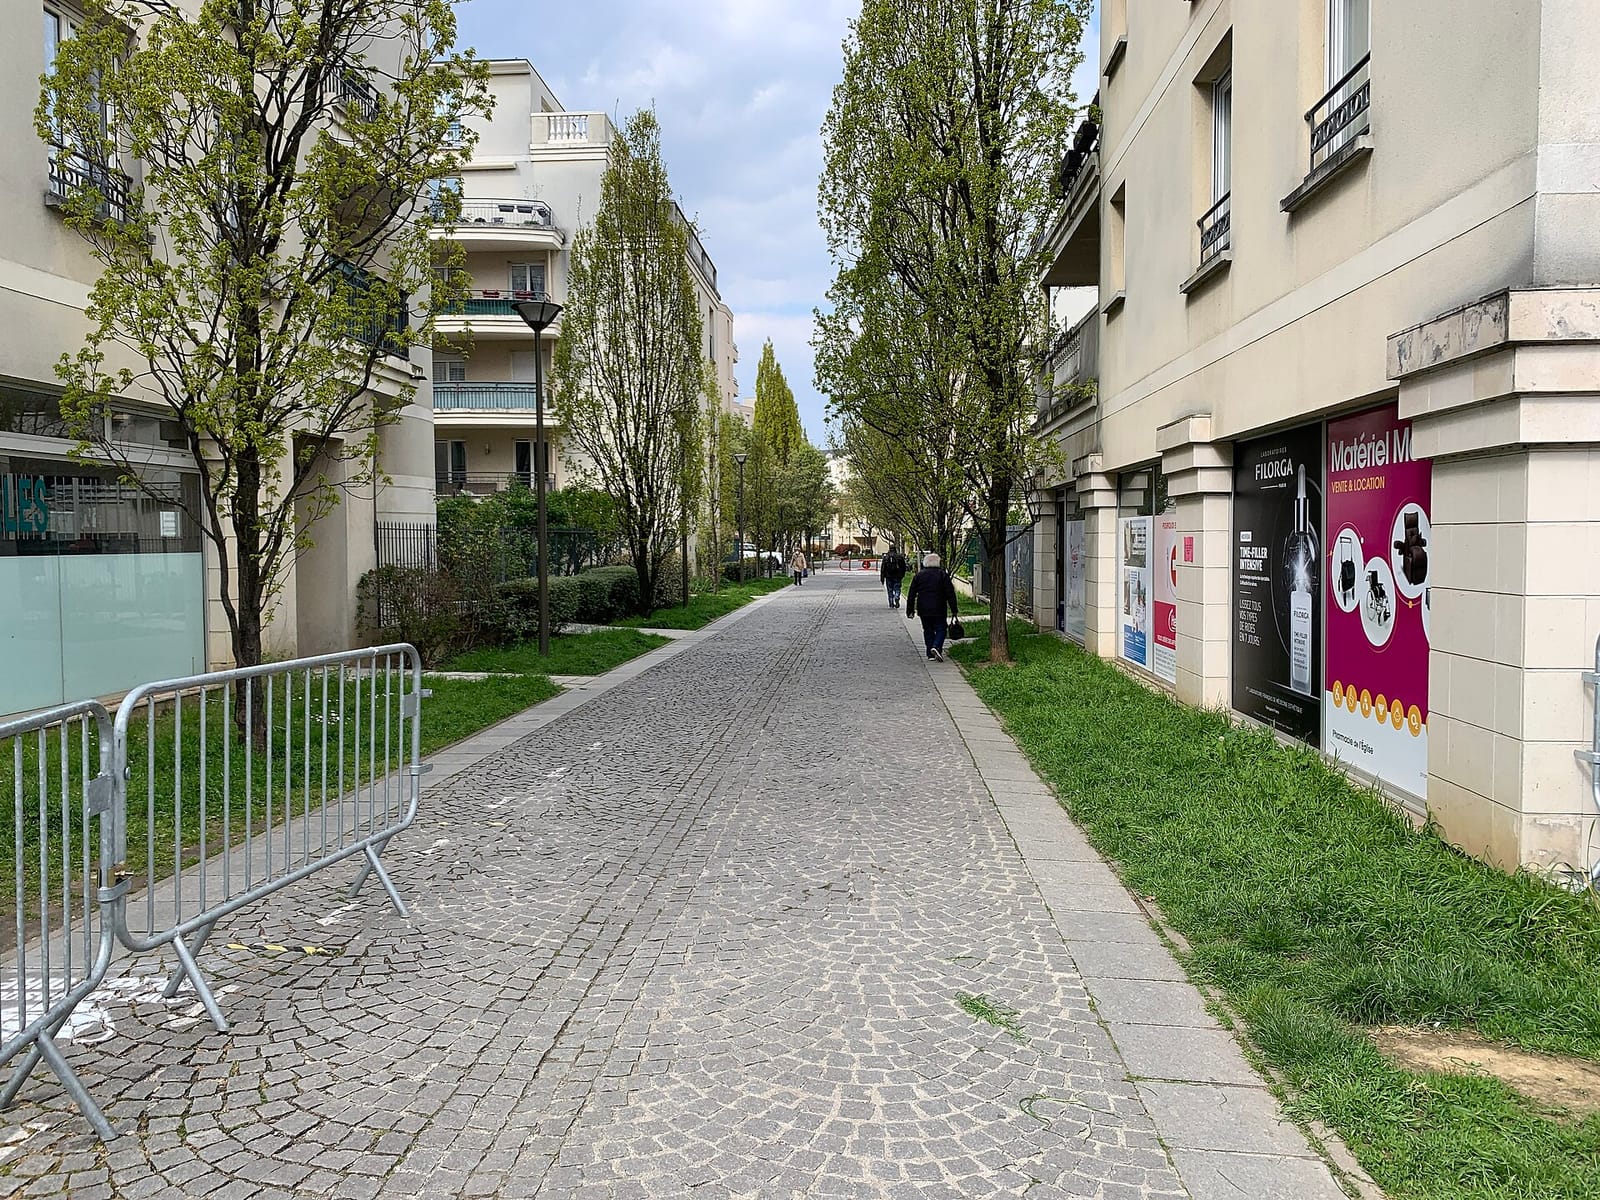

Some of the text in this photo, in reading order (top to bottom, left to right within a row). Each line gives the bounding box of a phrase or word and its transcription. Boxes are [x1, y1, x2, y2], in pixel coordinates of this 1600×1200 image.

[1331, 431, 1390, 473] Matériel
[1255, 457, 1293, 481] FILORGA
[1331, 480, 1348, 494] VENTE
[1353, 476, 1385, 491] LOCATION
[0, 478, 49, 533] LES
[1240, 546, 1268, 559] TIME-FILLER
[1240, 558, 1263, 572] INTENSIVE
